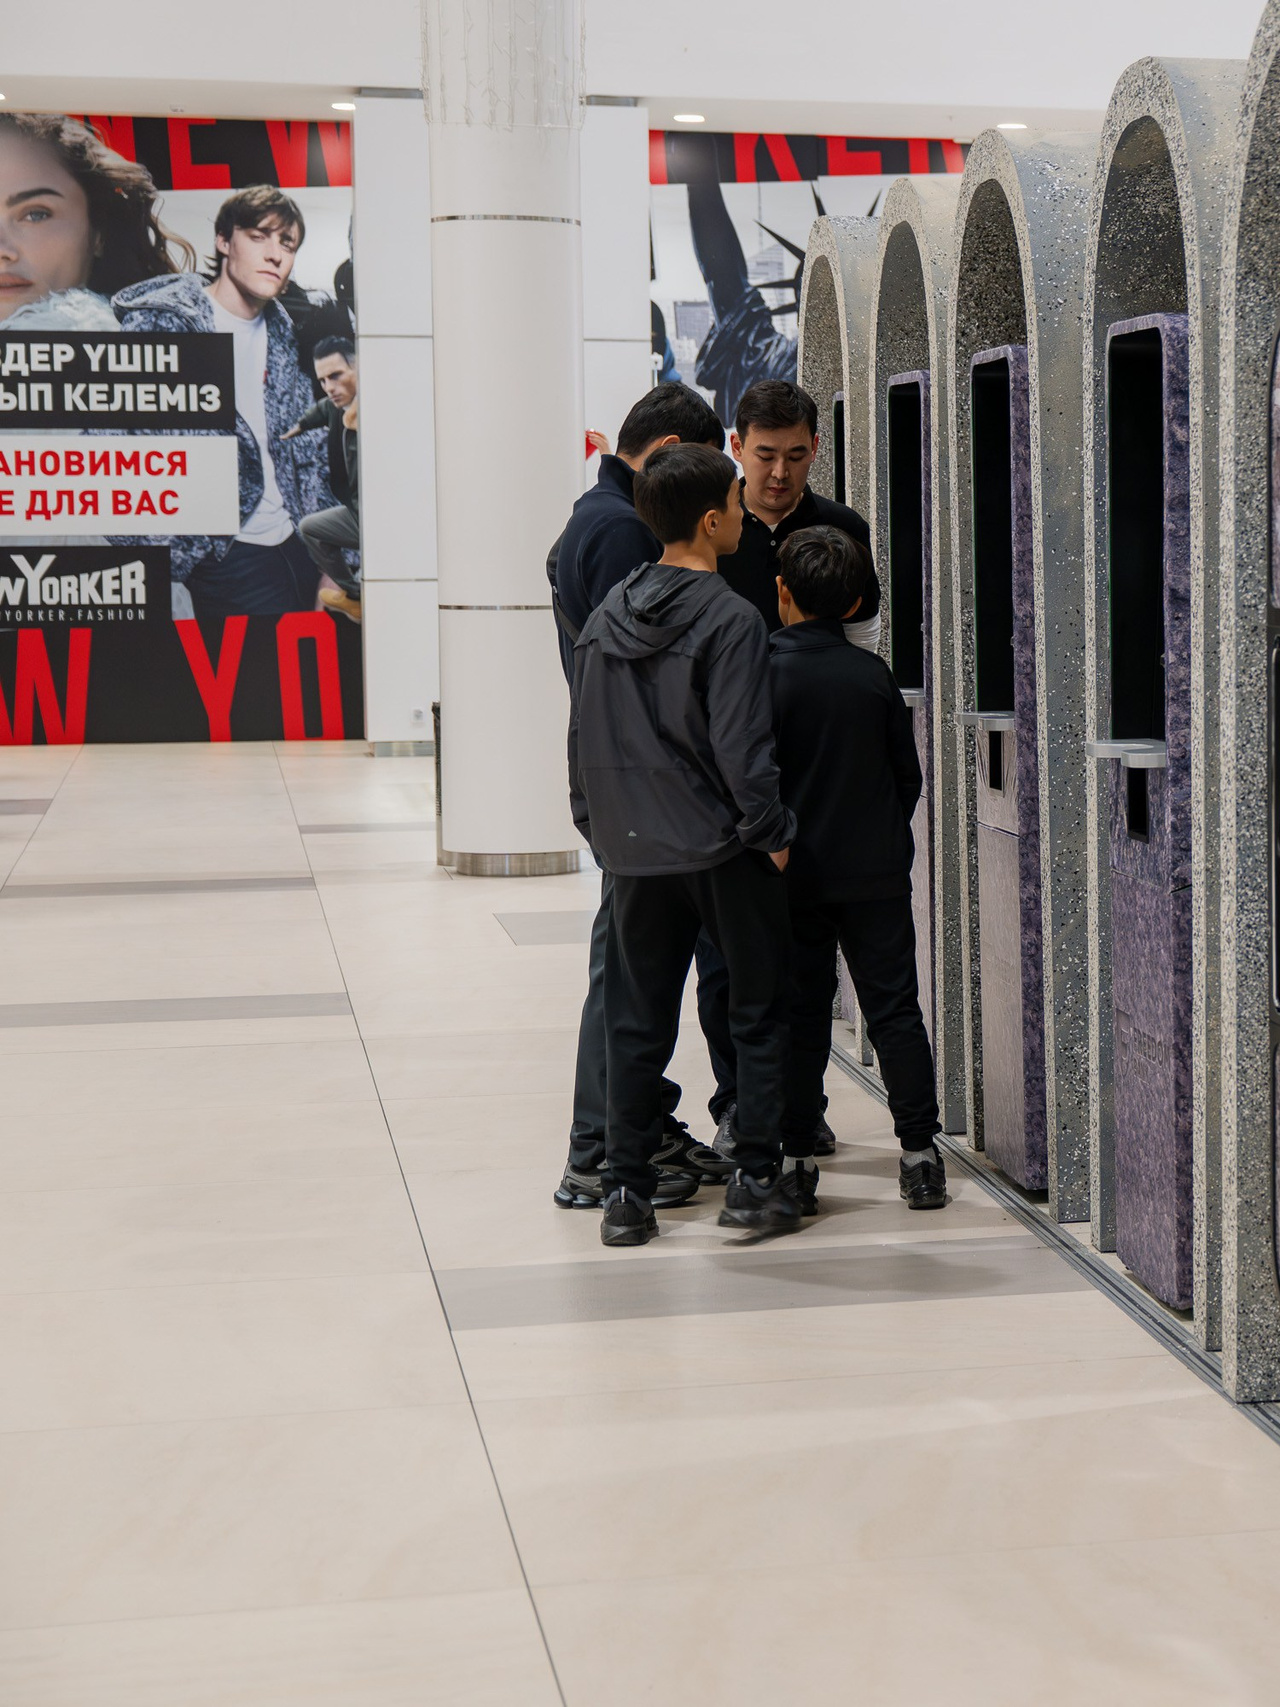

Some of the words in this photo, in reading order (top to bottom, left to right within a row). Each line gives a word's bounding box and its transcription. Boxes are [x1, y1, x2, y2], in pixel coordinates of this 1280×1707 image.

[0, 343, 75, 376] ДЕР
[25, 490, 99, 521] ДЛЯ
[112, 489, 179, 516] ВАС
